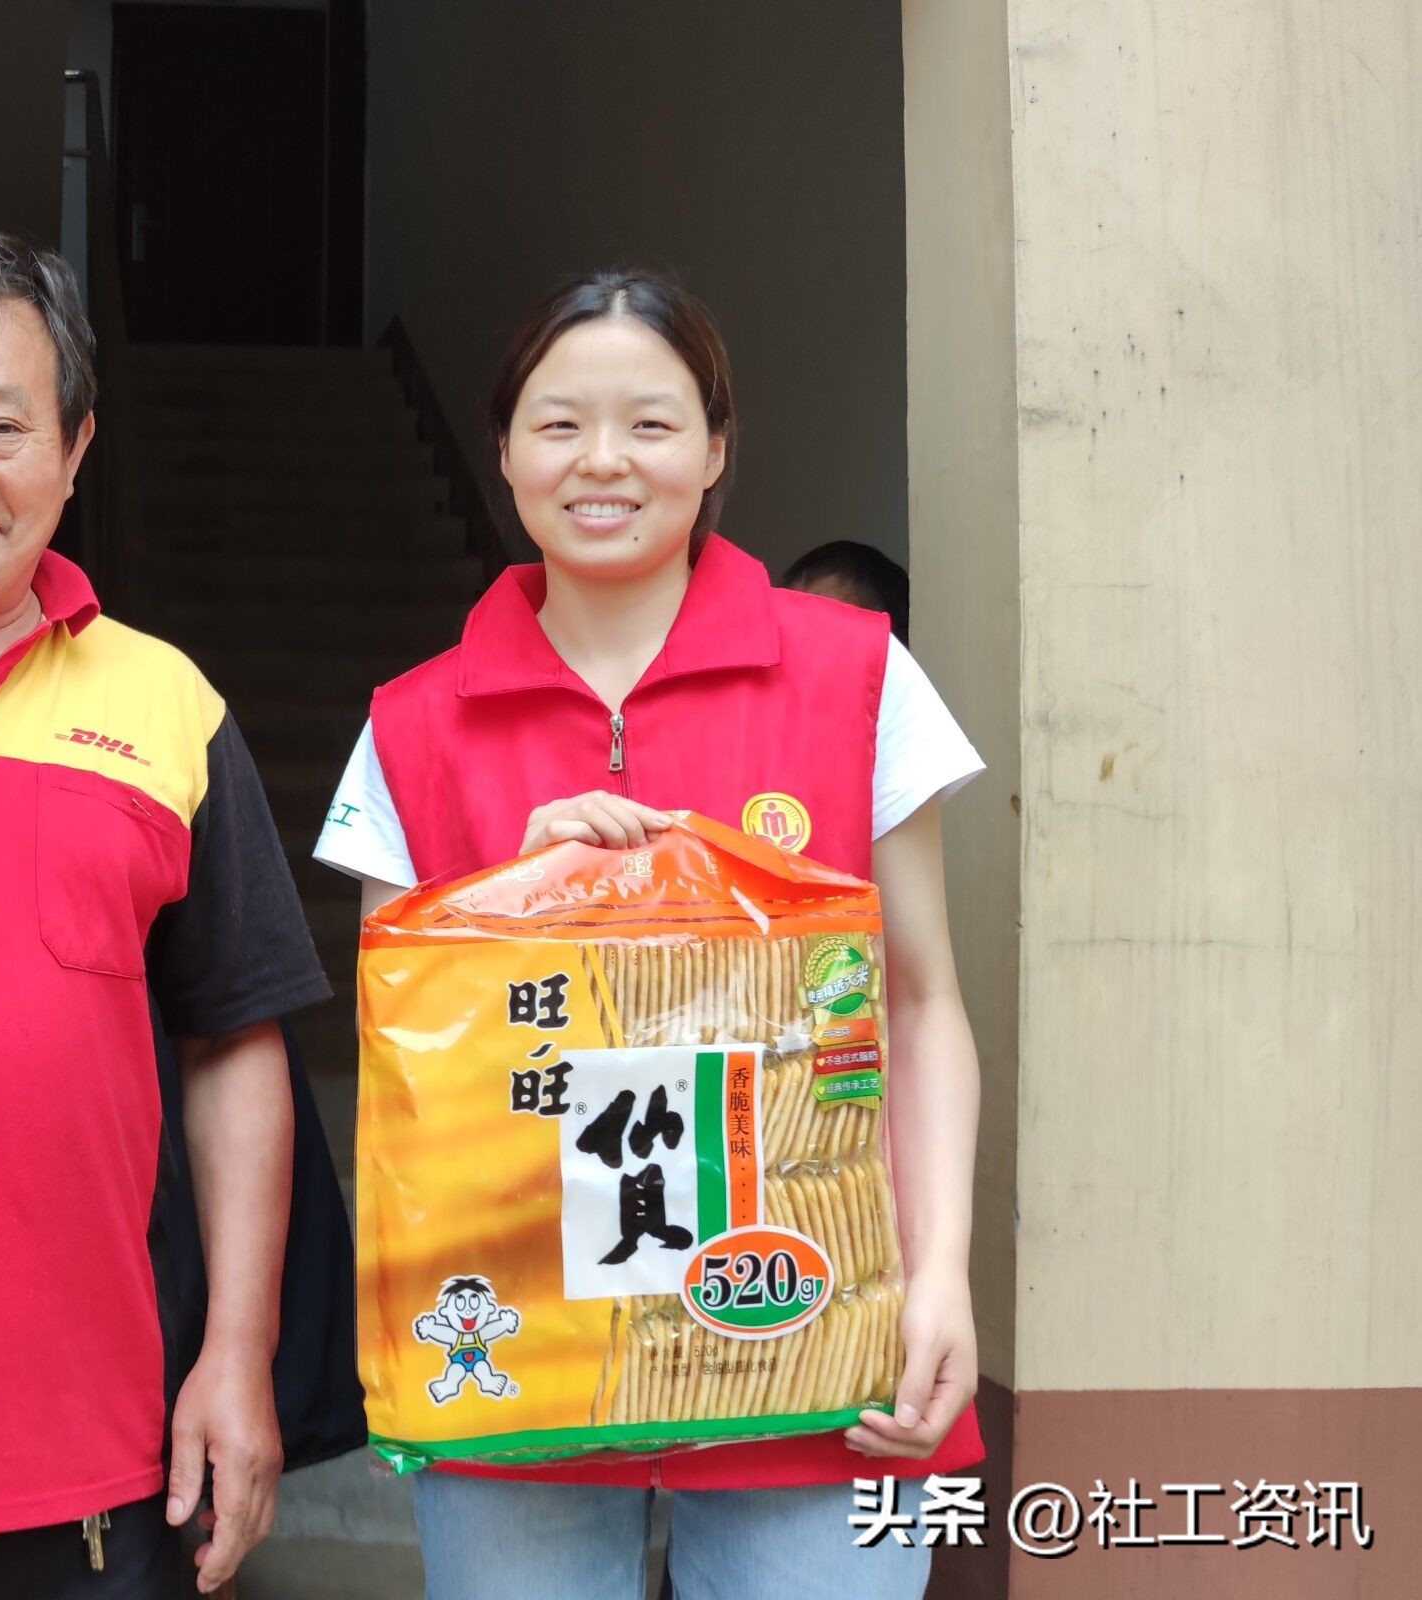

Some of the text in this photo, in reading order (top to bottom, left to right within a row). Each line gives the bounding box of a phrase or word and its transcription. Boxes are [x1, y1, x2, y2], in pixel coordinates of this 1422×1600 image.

[69, 728, 138, 760] DHL
[326, 799, 361, 827] 工
[729, 1067, 752, 1159] 香脆美味
[701, 1250, 815, 1309] 520g
